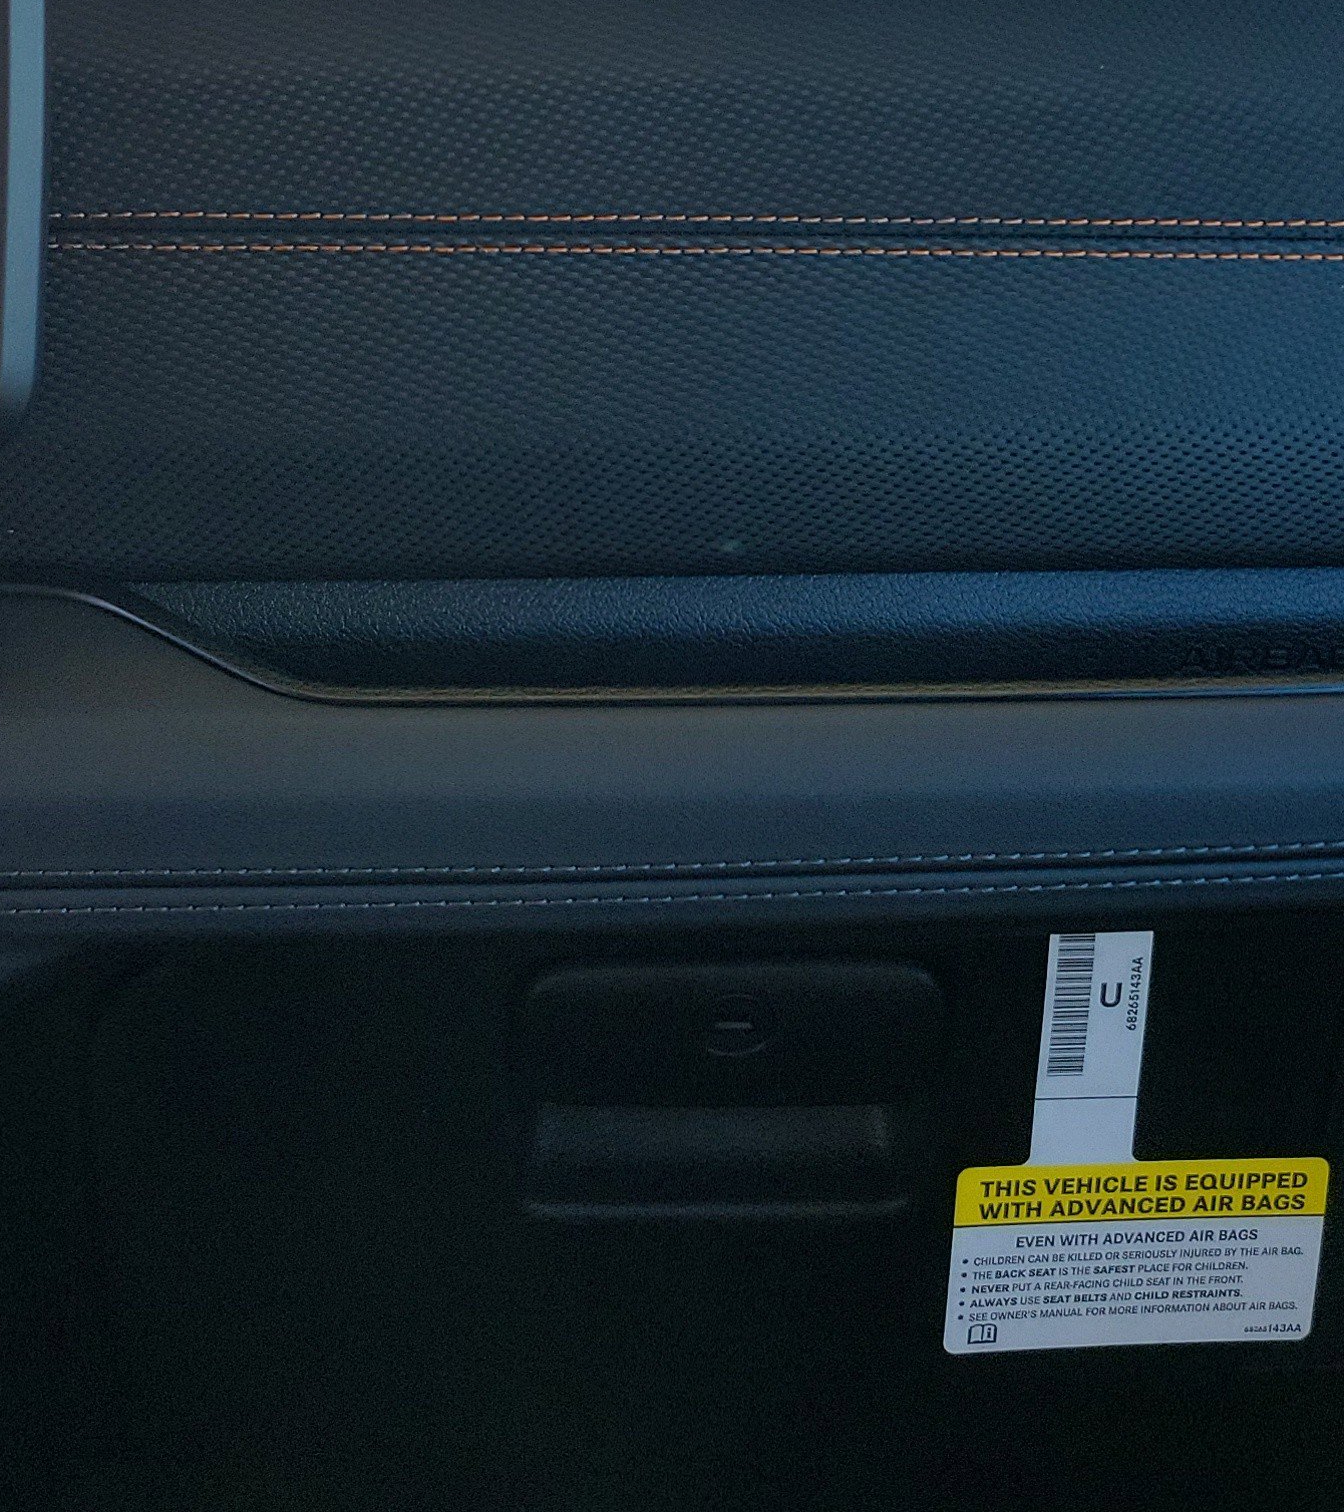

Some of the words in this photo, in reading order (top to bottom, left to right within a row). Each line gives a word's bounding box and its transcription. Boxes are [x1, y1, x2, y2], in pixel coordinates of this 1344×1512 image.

[1099, 982, 1123, 1008] U
[1126, 956, 1144, 1031] 68265143AA
[980, 1179, 1036, 1198] THIS
[1043, 1175, 1148, 1195] VEHICLE
[1154, 1174, 1178, 1192] IS
[1184, 1172, 1308, 1191] EQUIPPED
[978, 1200, 1042, 1220] WITH
[1049, 1196, 1186, 1217] ADVANCED
[1191, 1194, 1233, 1212] AIR
[1240, 1193, 1305, 1211] BAGS
[1015, 1234, 1055, 1248] EVEN
[1059, 1233, 1099, 1246] WITH
[1102, 1230, 1185, 1245] ADVANCED
[1188, 1229, 1214, 1242] AIR
[1218, 1228, 1258, 1241] BAGS
[972, 1254, 1025, 1267] CHILDREN
[1026, 1253, 1049, 1264] CAN
[1051, 1252, 1065, 1263] BE
[1066, 1251, 1103, 1262] KILLED
[1104, 1250, 1120, 1261] OR
[1121, 1249, 1178, 1260] SERIOUSLY
[1178, 1247, 1222, 1259] INJURED
[1223, 1247, 1238, 1257] BY
[1239, 1246, 1259, 1257] THE
[1260, 1246, 1278, 1256] AIR
[1280, 1245, 1304, 1255] BAG.
[972, 1270, 993, 1280] THE
[994, 1268, 1026, 1279] BACK
[1027, 1267, 1057, 1277] SEAT
[1057, 1266, 1069, 1276] IS
[1070, 1265, 1091, 1276] THE
[1092, 1264, 1136, 1275] SAFEST
[1137, 1262, 1170, 1273] PLACE
[1171, 1262, 1192, 1272] FOR
[1194, 1260, 1248, 1271] CHILDREN.
[970, 1283, 1010, 1294] NEVER
[1011, 1281, 1032, 1292] PUT
[1032, 1281, 1042, 1291] A
[1043, 1278, 1110, 1291] REAR-FACING
[1111, 1277, 1144, 1288] CHILD
[1145, 1276, 1171, 1286] SEAT
[1172, 1276, 1184, 1286] IN
[1186, 1275, 1206, 1285] THE
[1207, 1274, 1243, 1284] FRONT.
[969, 1296, 1018, 1308] ALWAYS
[1019, 1295, 1040, 1306] USE
[1042, 1294, 1072, 1304] SEAT
[1073, 1292, 1107, 1303] BELTS
[1108, 1291, 1132, 1302] AND
[1133, 1290, 1169, 1300] CHILD
[1171, 1288, 1243, 1299] RESTRAINTS.
[967, 1311, 988, 1322] SEE
[989, 1309, 1037, 1321] OWNER'S
[1039, 1307, 1083, 1318] MANUAL
[1084, 1306, 1106, 1316] FOR
[1107, 1305, 1138, 1315] MORE
[1140, 1303, 1210, 1314] INFORMATION
[1211, 1301, 1247, 1312] ABOUT
[1247, 1300, 1266, 1311] AIR
[1267, 1300, 1298, 1310] BAGS.
